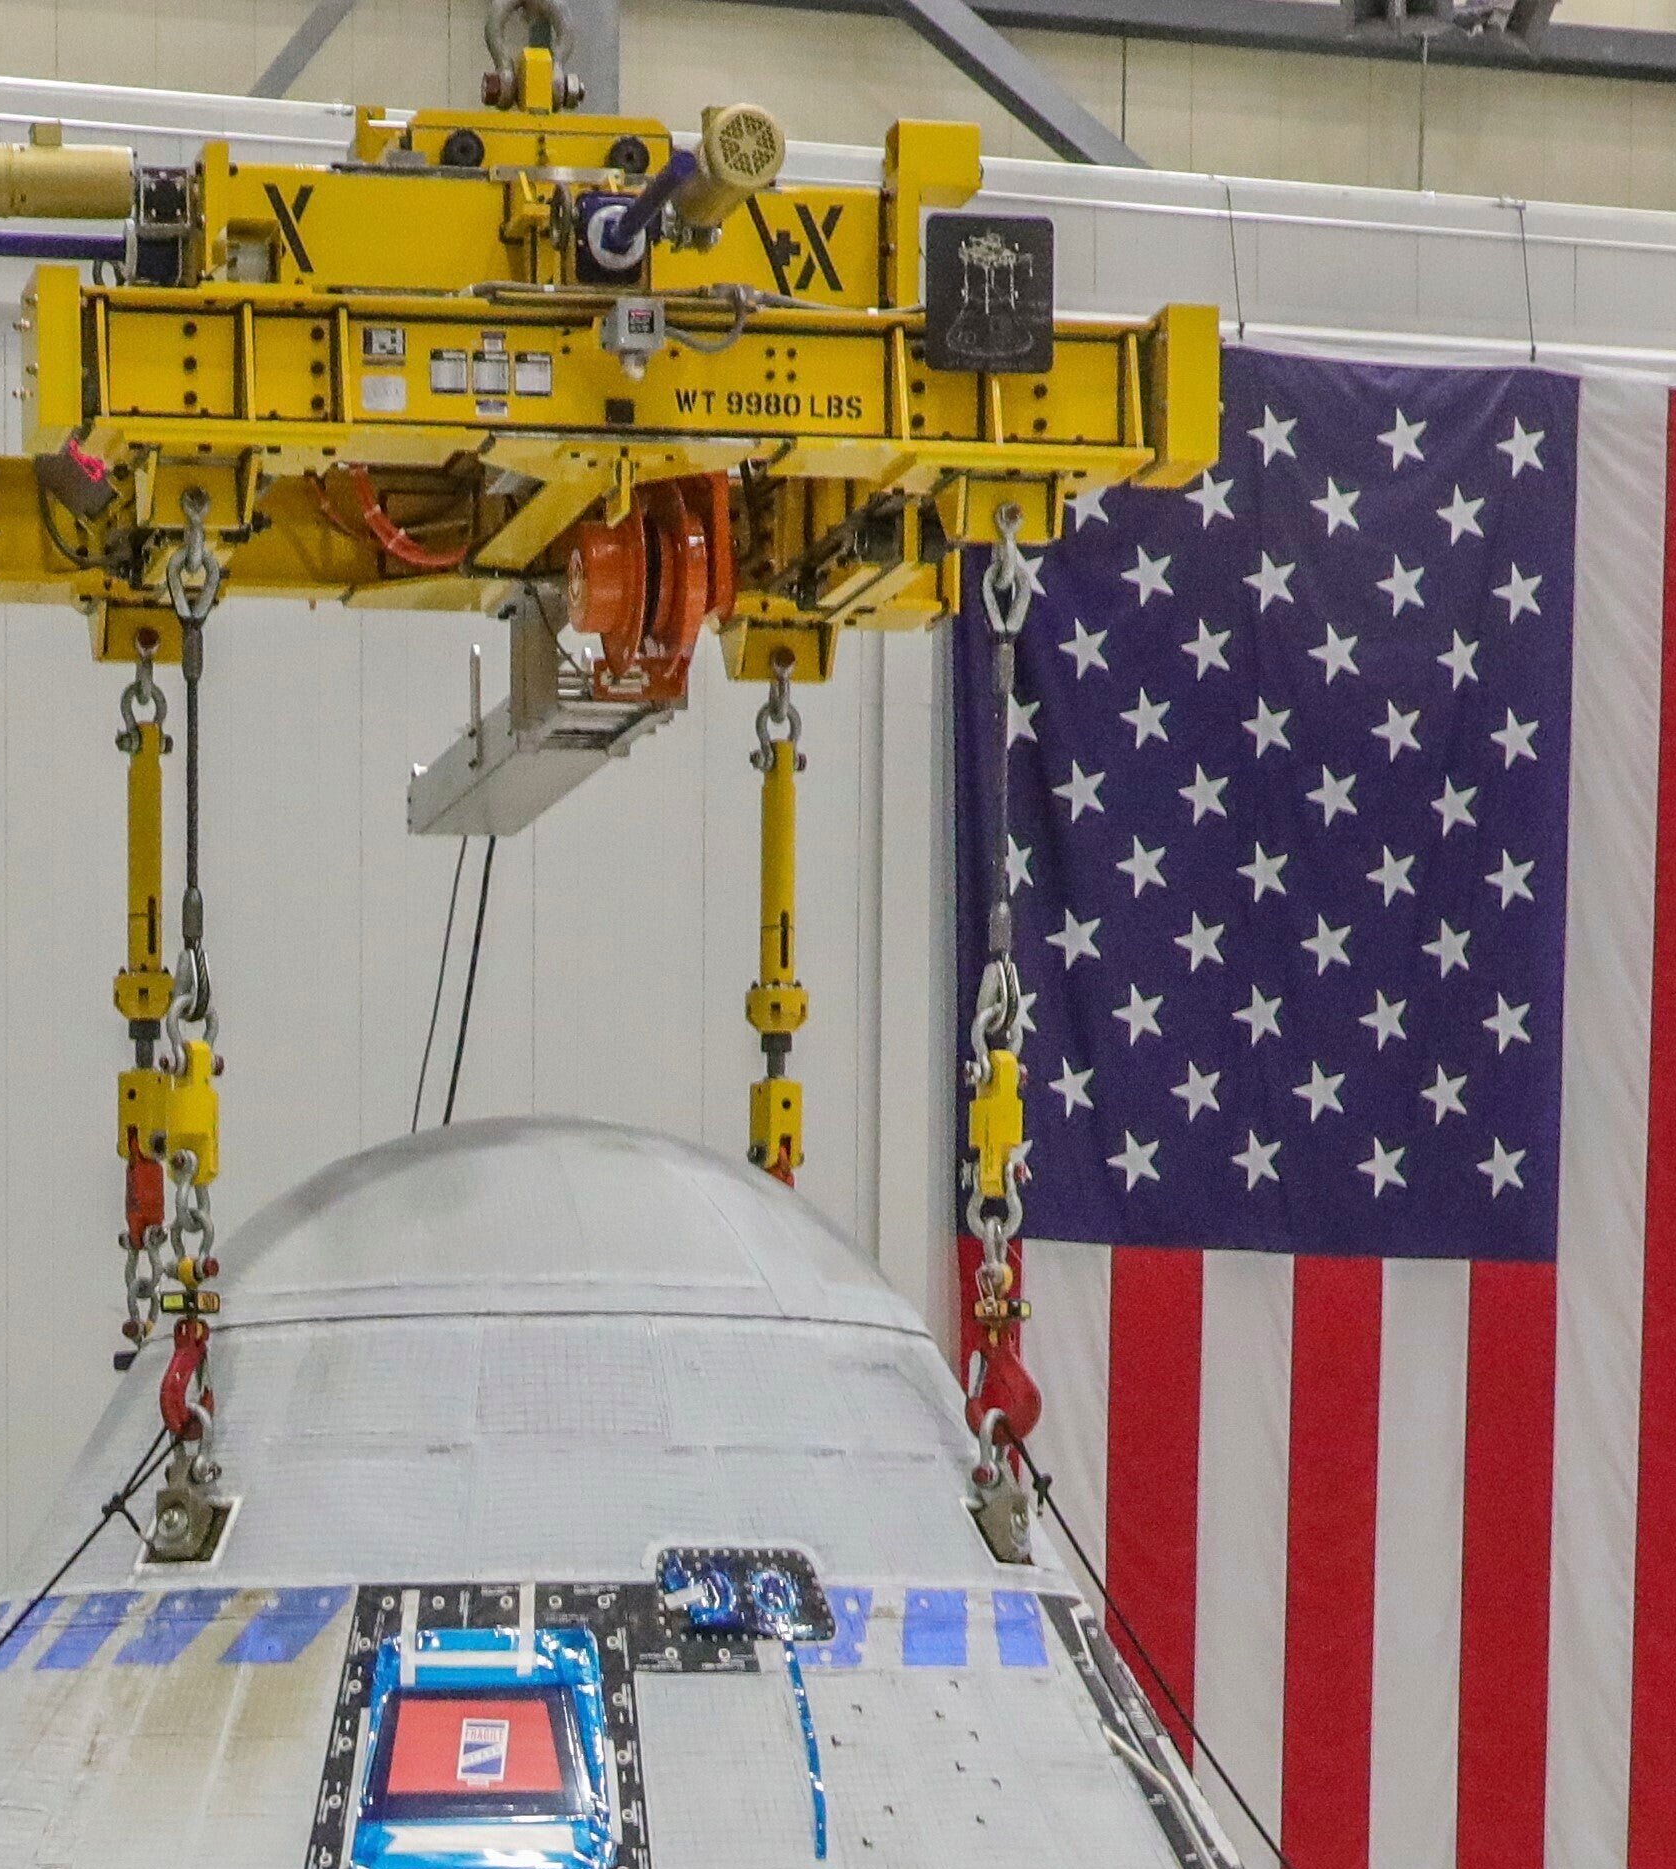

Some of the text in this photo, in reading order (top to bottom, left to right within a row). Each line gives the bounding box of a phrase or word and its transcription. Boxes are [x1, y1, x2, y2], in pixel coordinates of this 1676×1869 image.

[675, 387, 863, 419] WT 9980 LBS
